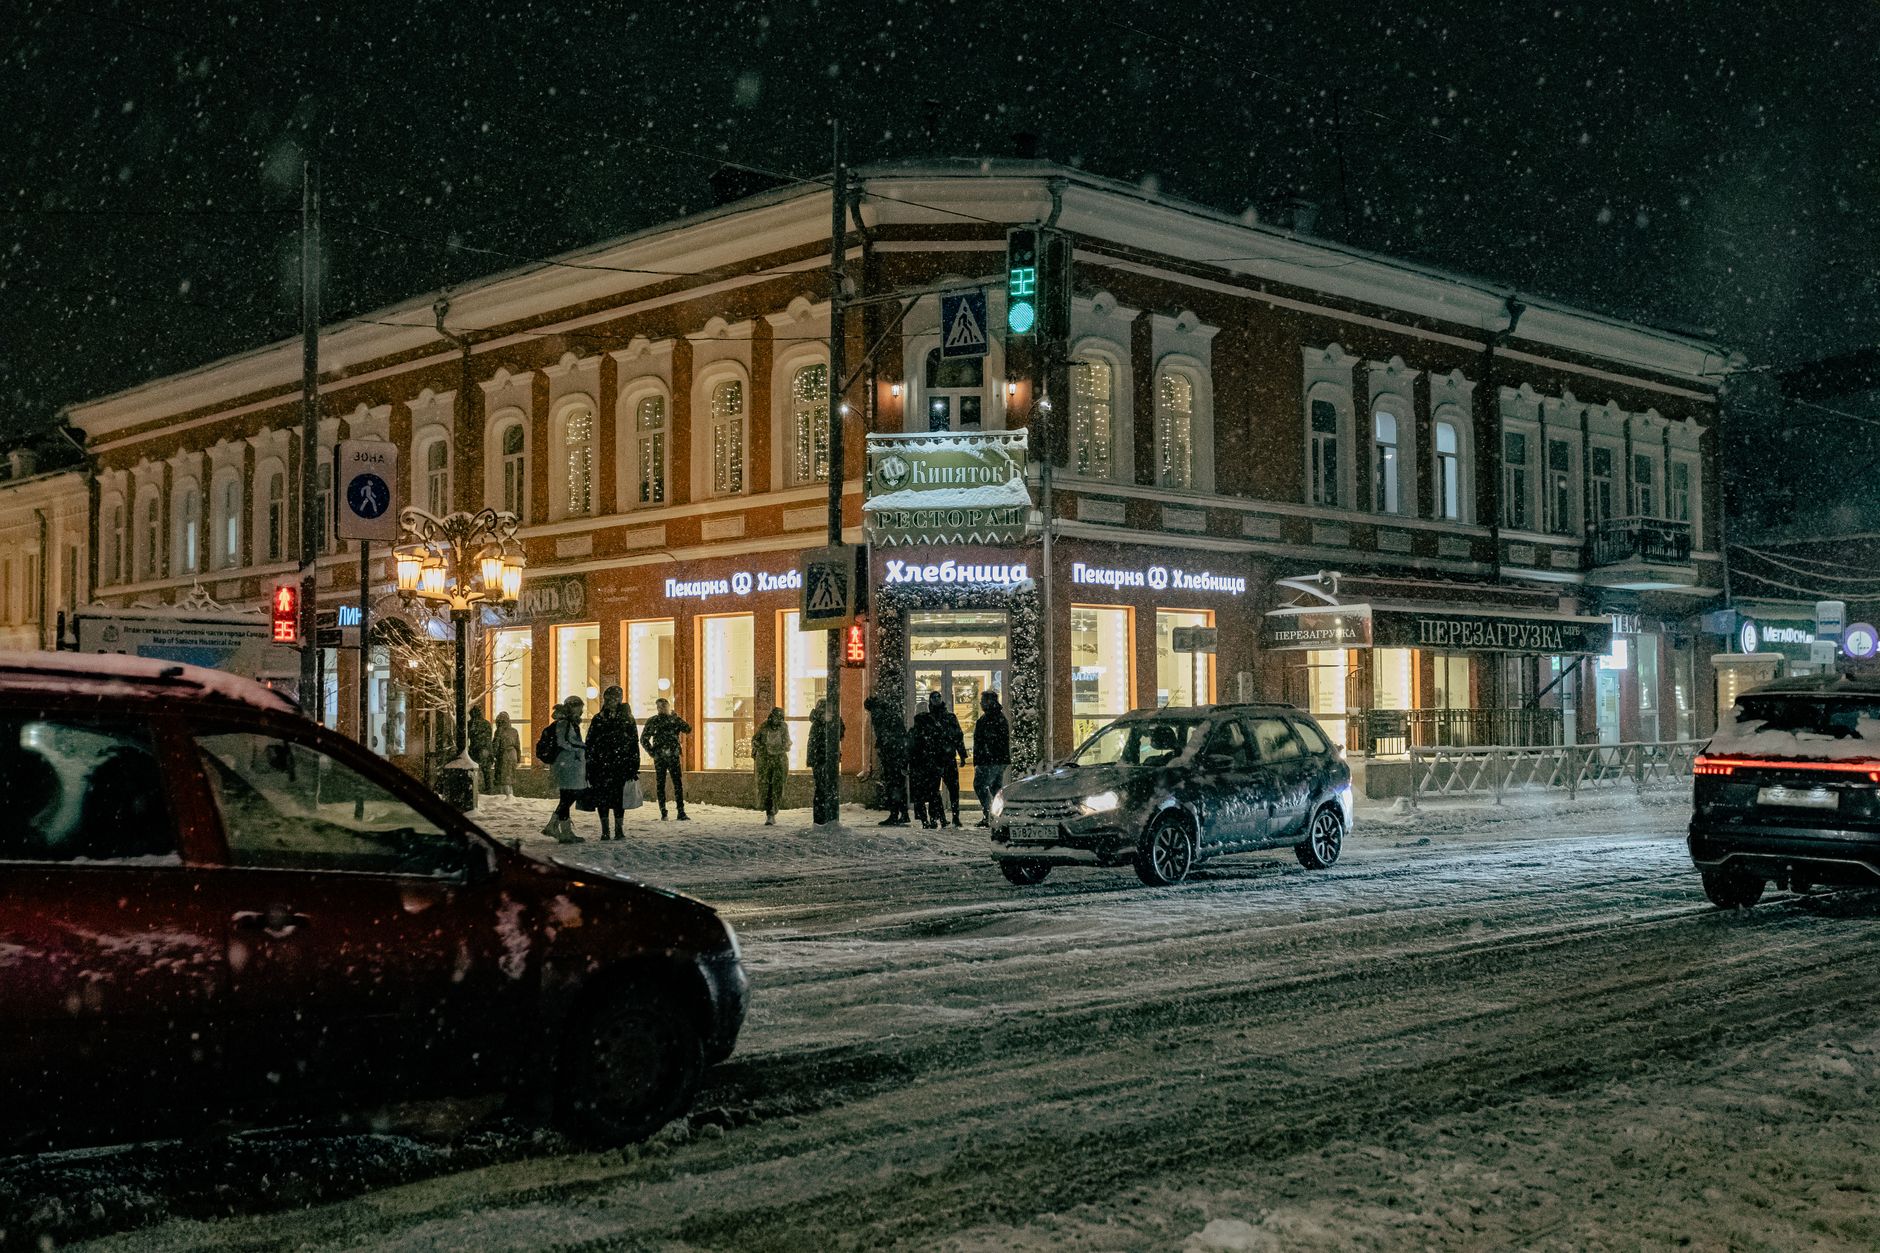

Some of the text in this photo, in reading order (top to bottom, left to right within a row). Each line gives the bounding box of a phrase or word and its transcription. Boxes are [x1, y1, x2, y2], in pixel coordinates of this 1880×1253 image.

[1011, 268, 1034, 295] 32
[353, 451, 385, 463] ЗОНА
[876, 508, 1021, 530] РЕСТОРАН
[886, 560, 1028, 585] Хлебница
[1073, 563, 1245, 595] Пекарня Хлебница
[665, 579, 729, 600] Пекарня
[274, 621, 294, 640] 35
[1418, 618, 1563, 649] ПЕРЕЗАГРУЗКА
[847, 643, 865, 660] 36
